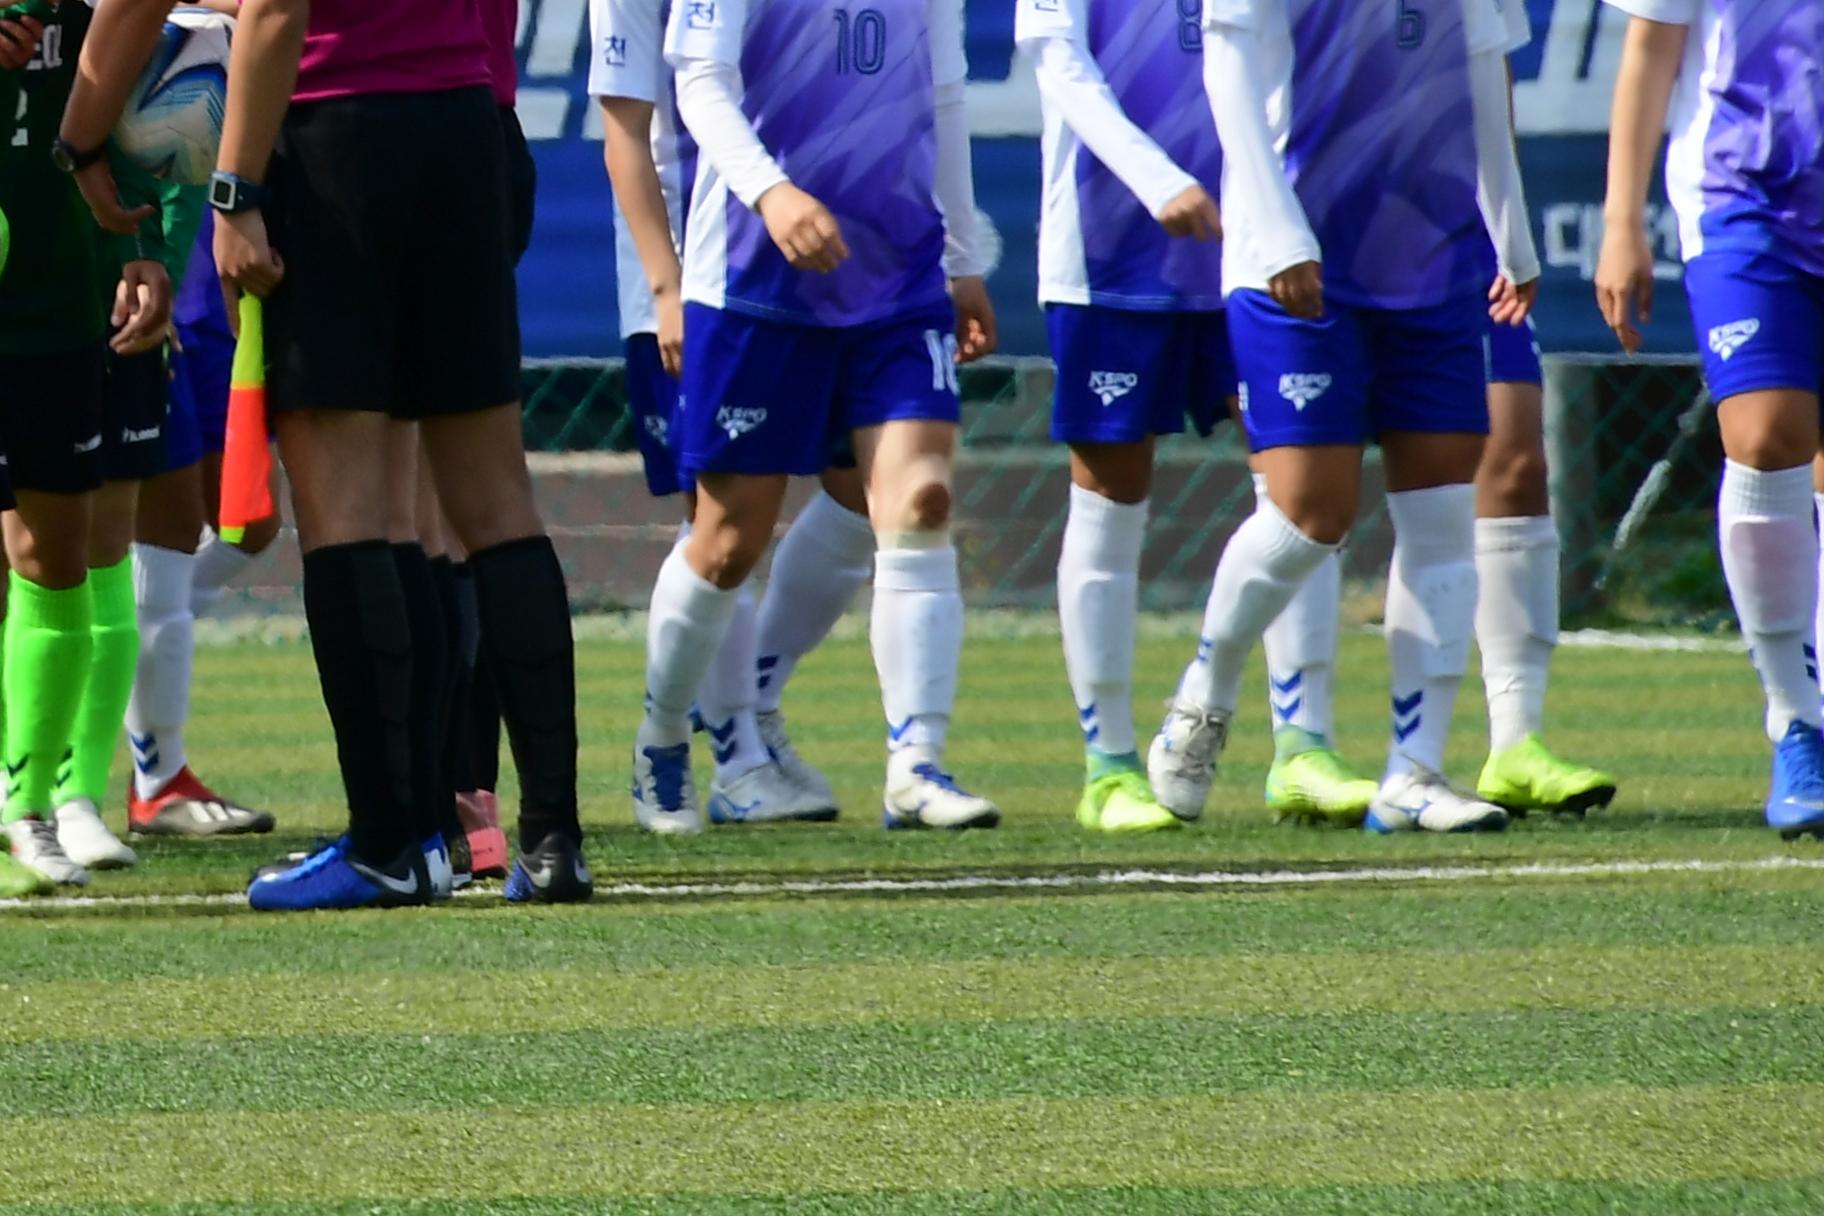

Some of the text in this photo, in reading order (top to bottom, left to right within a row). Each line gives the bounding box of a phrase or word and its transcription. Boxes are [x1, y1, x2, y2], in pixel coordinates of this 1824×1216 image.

[686, 0, 716, 31] 천
[604, 34, 627, 68] 천
[833, 7, 887, 75] 10
